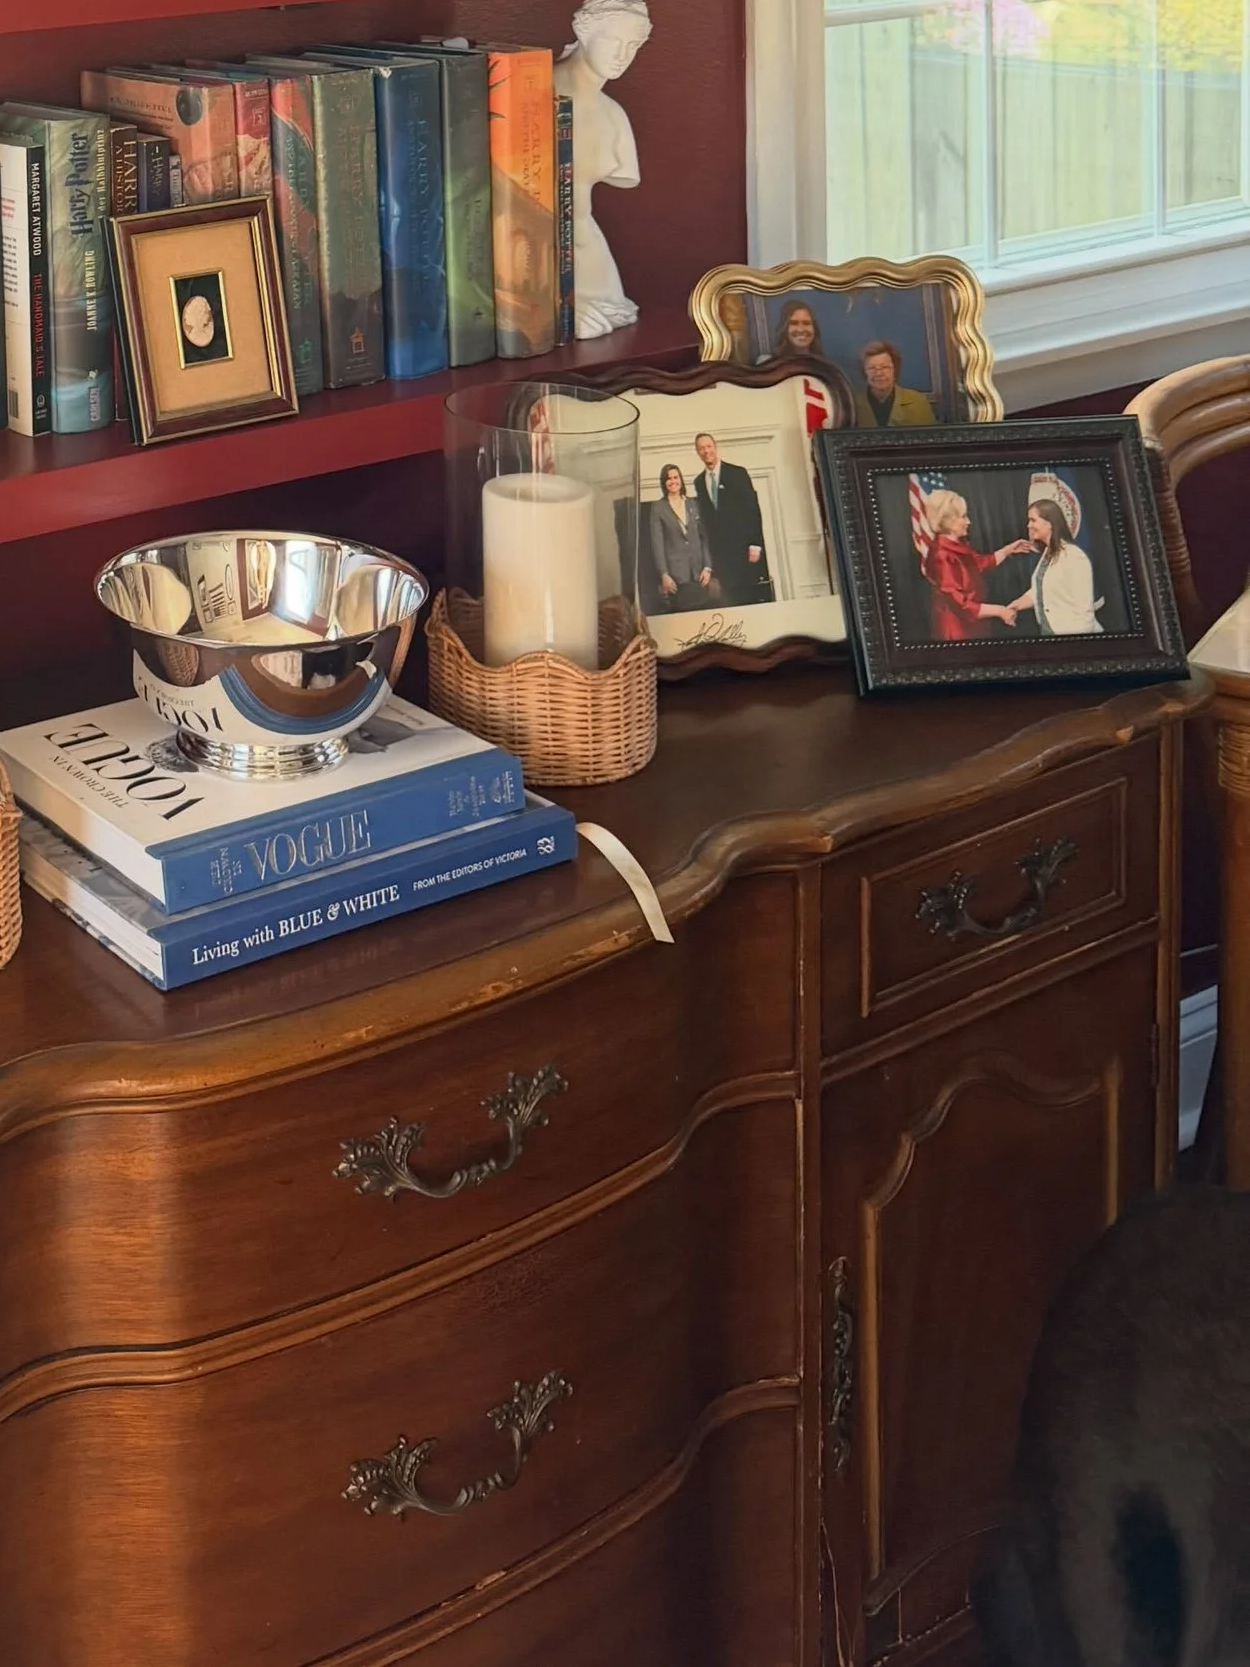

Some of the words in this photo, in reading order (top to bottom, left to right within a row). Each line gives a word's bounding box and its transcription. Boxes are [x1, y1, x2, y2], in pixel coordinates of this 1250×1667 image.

[31, 162, 42, 214] MARGARET
[32, 215, 43, 256] ATWOOD
[43, 722, 205, 822] VOGUE
[245, 808, 373, 883] VOGUE
[412, 876, 437, 892] FROM
[437, 871, 451, 884] THE
[451, 861, 482, 881] EDITORS
[483, 858, 495, 869] OF
[494, 847, 528, 867] VICTORIA
[192, 940, 240, 966] Living
[242, 926, 275, 948] with
[278, 908, 323, 939] BLUE
[327, 902, 340, 922] &
[343, 884, 401, 916] WHITE
